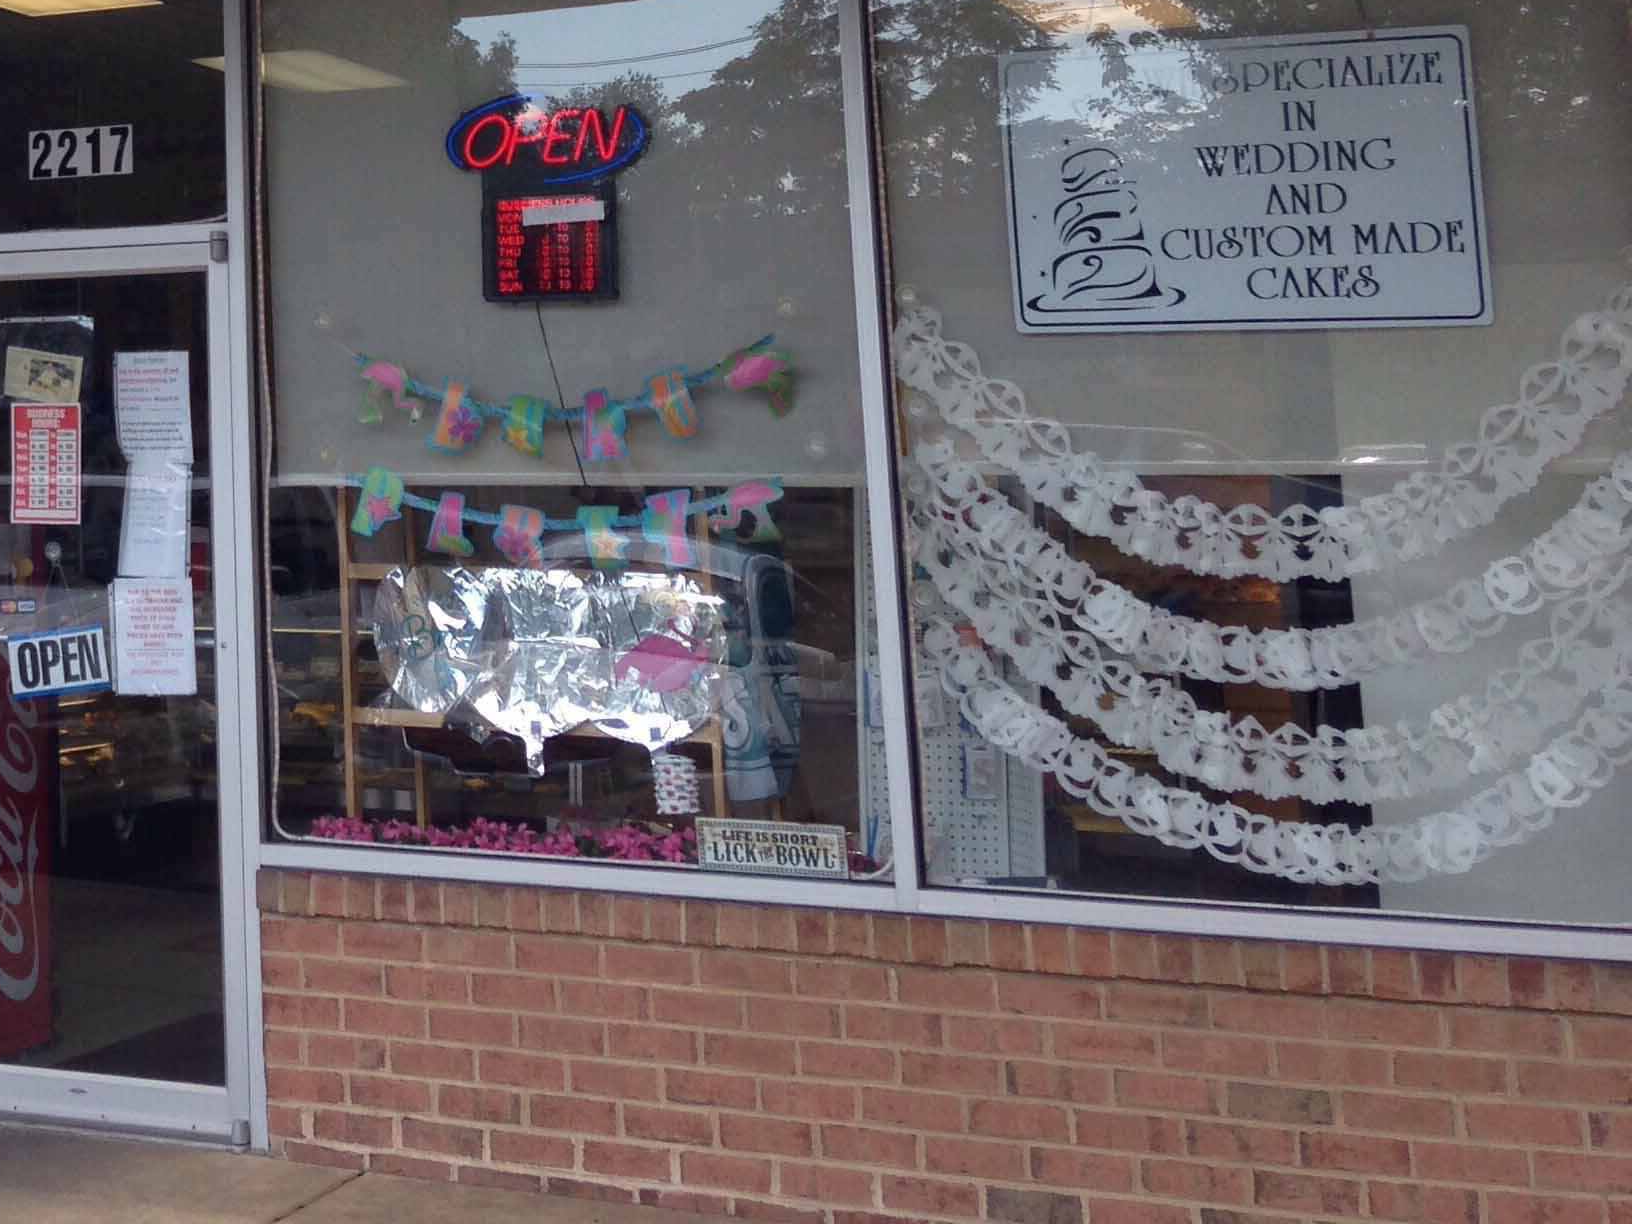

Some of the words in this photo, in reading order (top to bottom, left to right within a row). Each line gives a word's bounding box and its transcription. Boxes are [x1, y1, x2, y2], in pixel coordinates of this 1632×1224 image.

[1211, 51, 1442, 94] SPECIALIZE
[1281, 100, 1316, 131] IN
[32, 126, 129, 178] 2217
[464, 106, 626, 167] OPEN
[1194, 137, 1396, 177] WEDDING
[1265, 183, 1347, 216] AND
[1160, 225, 1334, 262] CUSTOM
[1353, 219, 1465, 255] MADE
[1247, 265, 1380, 300] CAKES
[17, 633, 103, 688] OPEN
[712, 842, 758, 863] LICK
[776, 845, 836, 869] BOWL
[722, 830, 753, 842] LIFE
[756, 832, 769, 843] IS
[772, 833, 819, 846] SHORT
